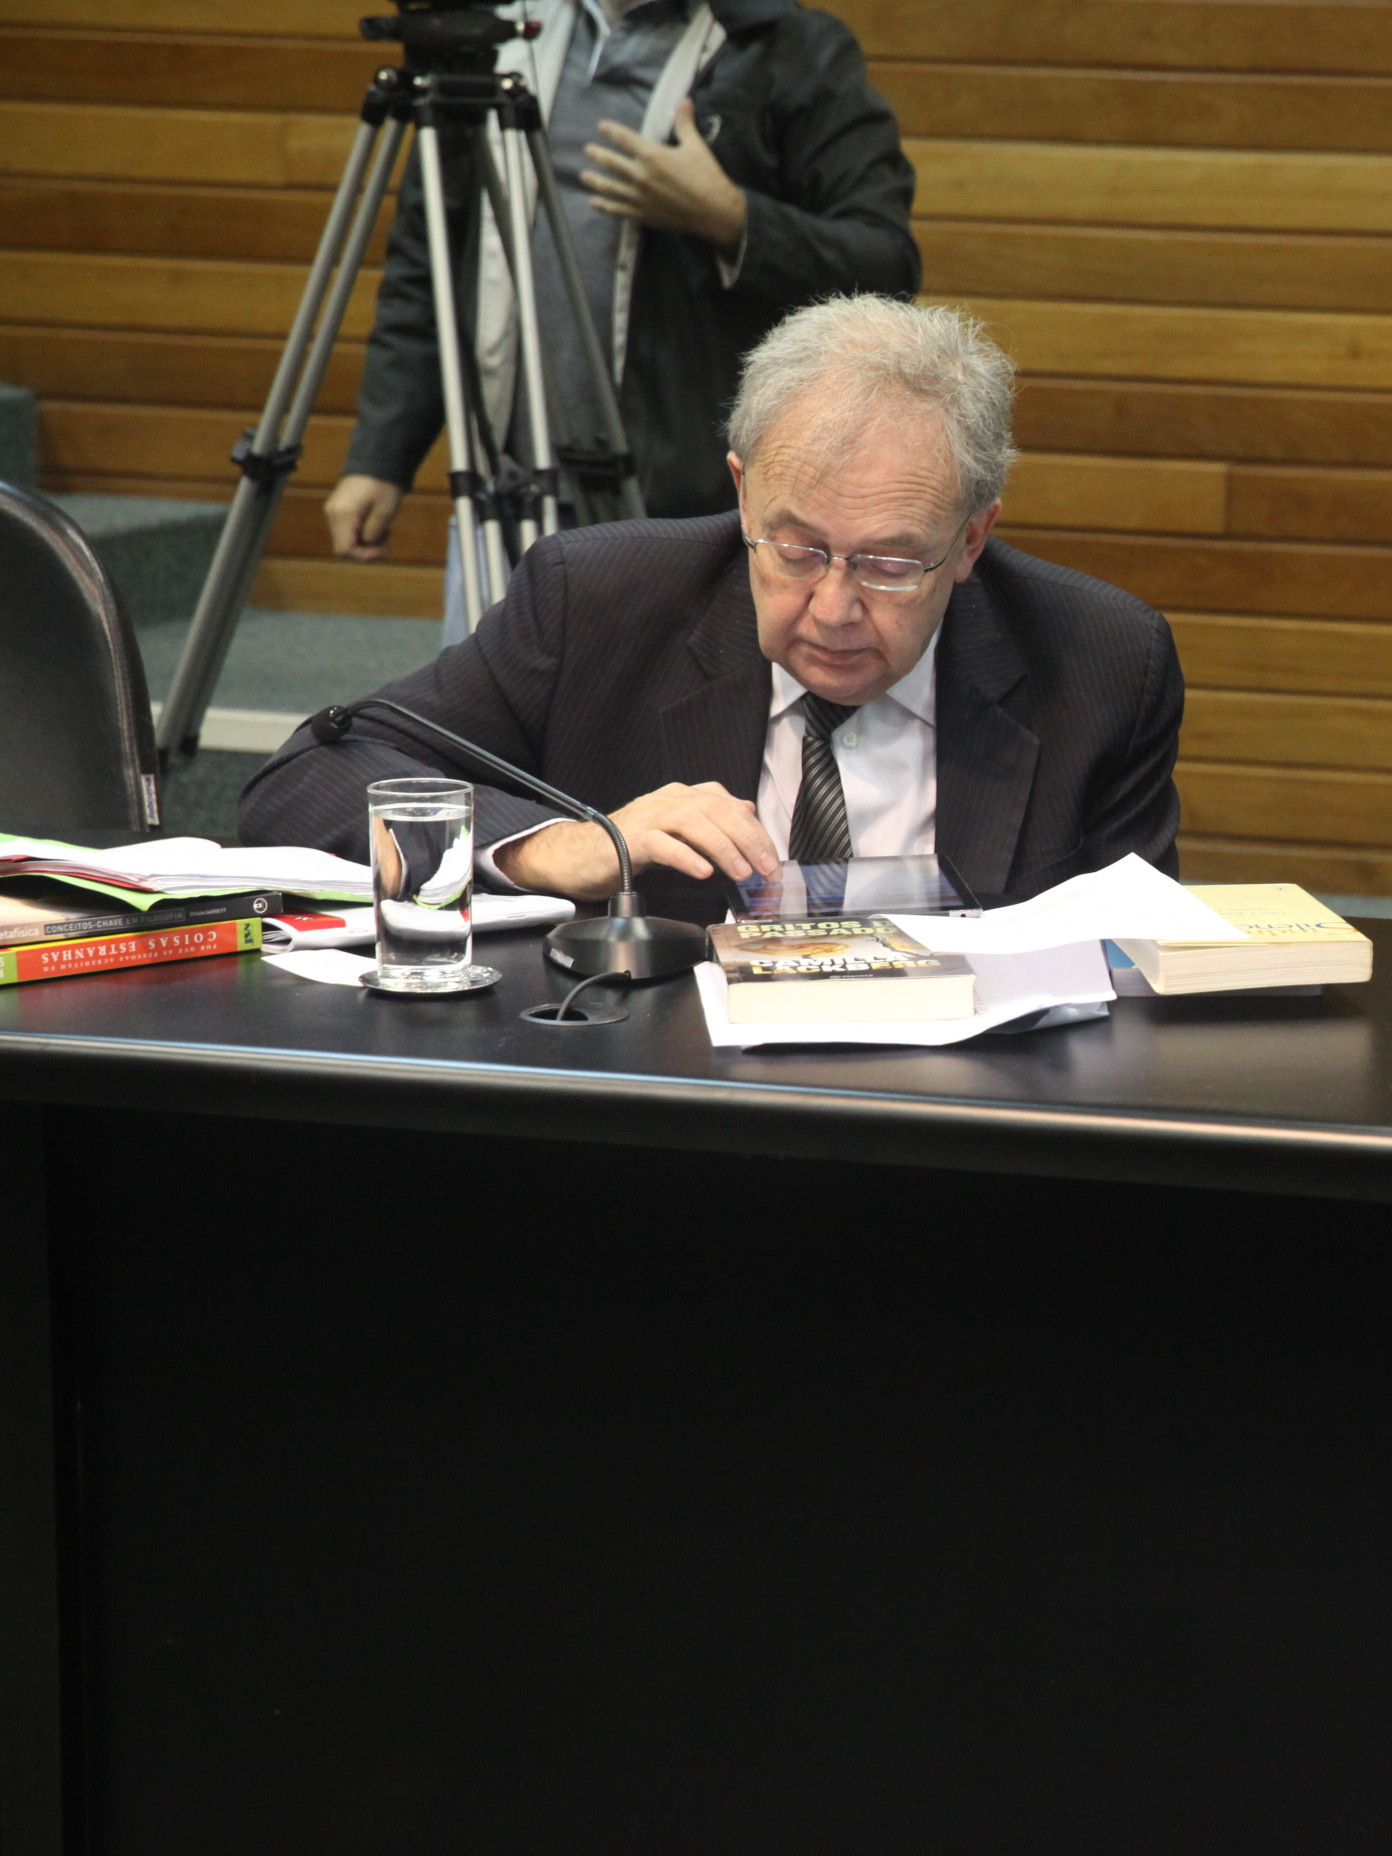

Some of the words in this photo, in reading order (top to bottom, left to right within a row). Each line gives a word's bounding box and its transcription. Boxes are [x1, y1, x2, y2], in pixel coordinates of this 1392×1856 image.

[45, 918, 124, 934] CONCEITOS-CHAVE
[737, 920, 862, 933] GRITOS
[739, 926, 900, 939] PASSADO
[148, 931, 217, 950] COISAS
[41, 941, 136, 964] ESTRANHAS
[119, 951, 158, 962] PESSOAS
[60, 957, 114, 970] ACREDITAM
[751, 954, 910, 968] CAMILLA
[751, 959, 942, 975] LACKBERG
